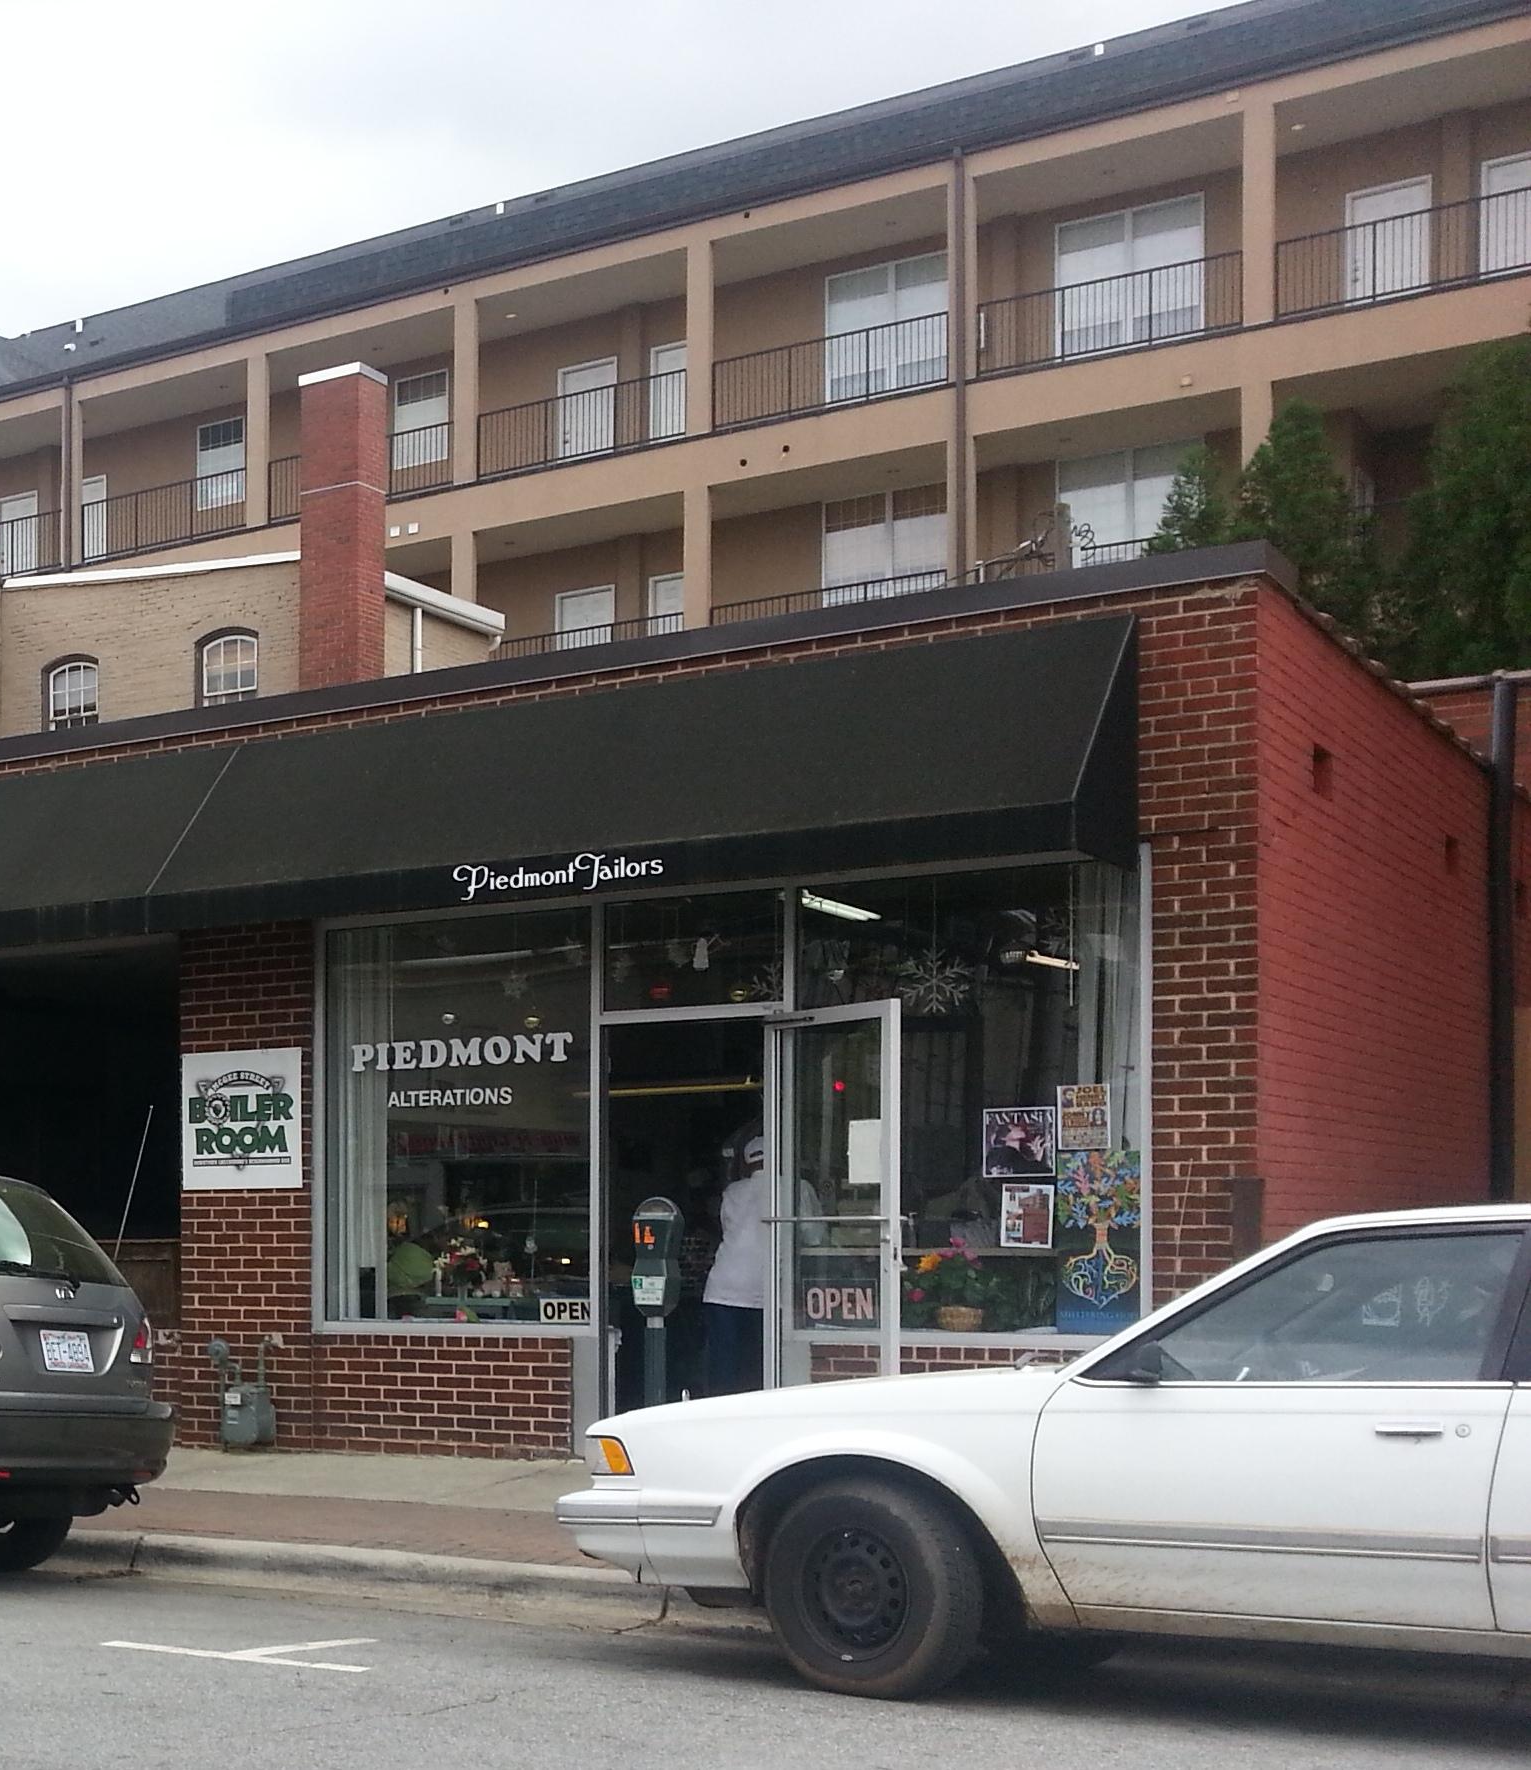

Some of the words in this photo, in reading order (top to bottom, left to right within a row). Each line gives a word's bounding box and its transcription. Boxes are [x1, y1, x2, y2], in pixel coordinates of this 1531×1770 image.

[453, 861, 575, 900] Piedmont
[574, 853, 664, 890] Tailors
[351, 1031, 574, 1072] PIEDMONT
[239, 1072, 271, 1089] STREET
[189, 1093, 294, 1124] BOILER
[388, 1087, 512, 1107] ALTERATIONS
[195, 1125, 289, 1155] ROOM
[543, 1302, 590, 1321] OPEN
[807, 1287, 874, 1320] OPEN
